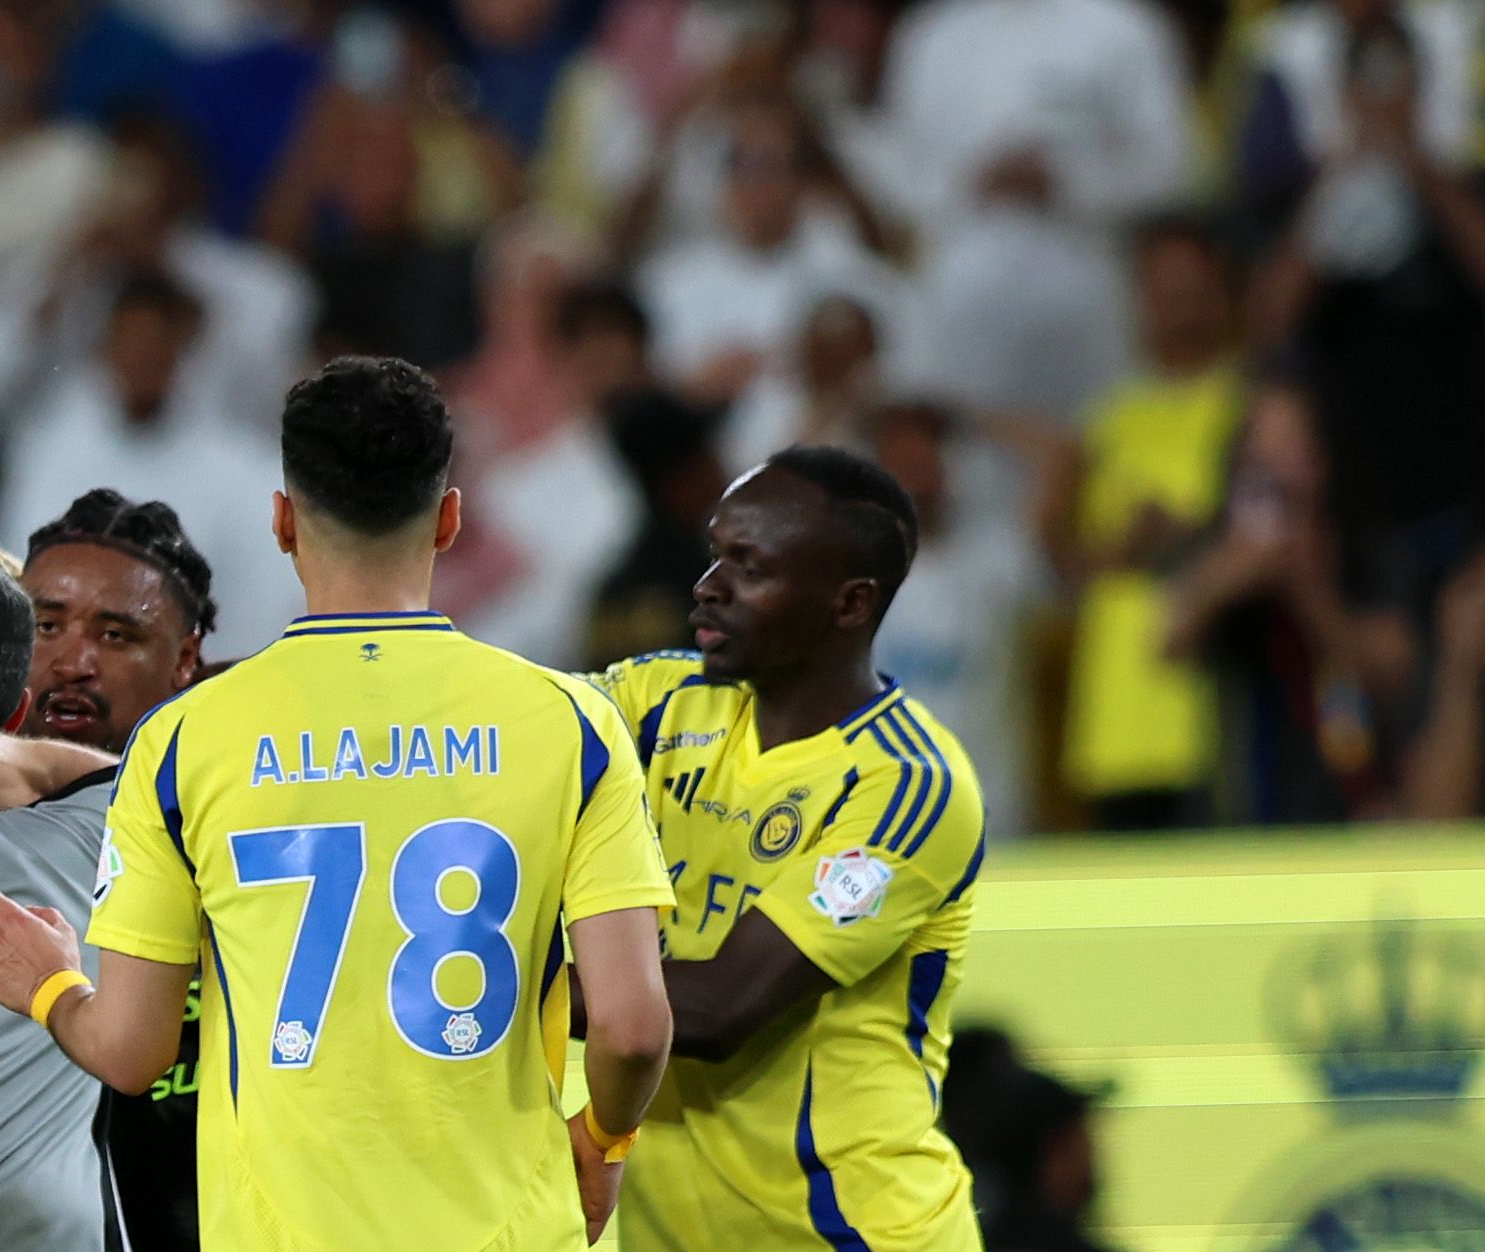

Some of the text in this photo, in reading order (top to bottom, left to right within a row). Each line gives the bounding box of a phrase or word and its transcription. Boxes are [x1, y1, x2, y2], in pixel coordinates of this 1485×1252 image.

[250, 724, 499, 787] A.LAJAMI
[839, 874, 862, 900] RSL
[228, 817, 520, 1069] 78
